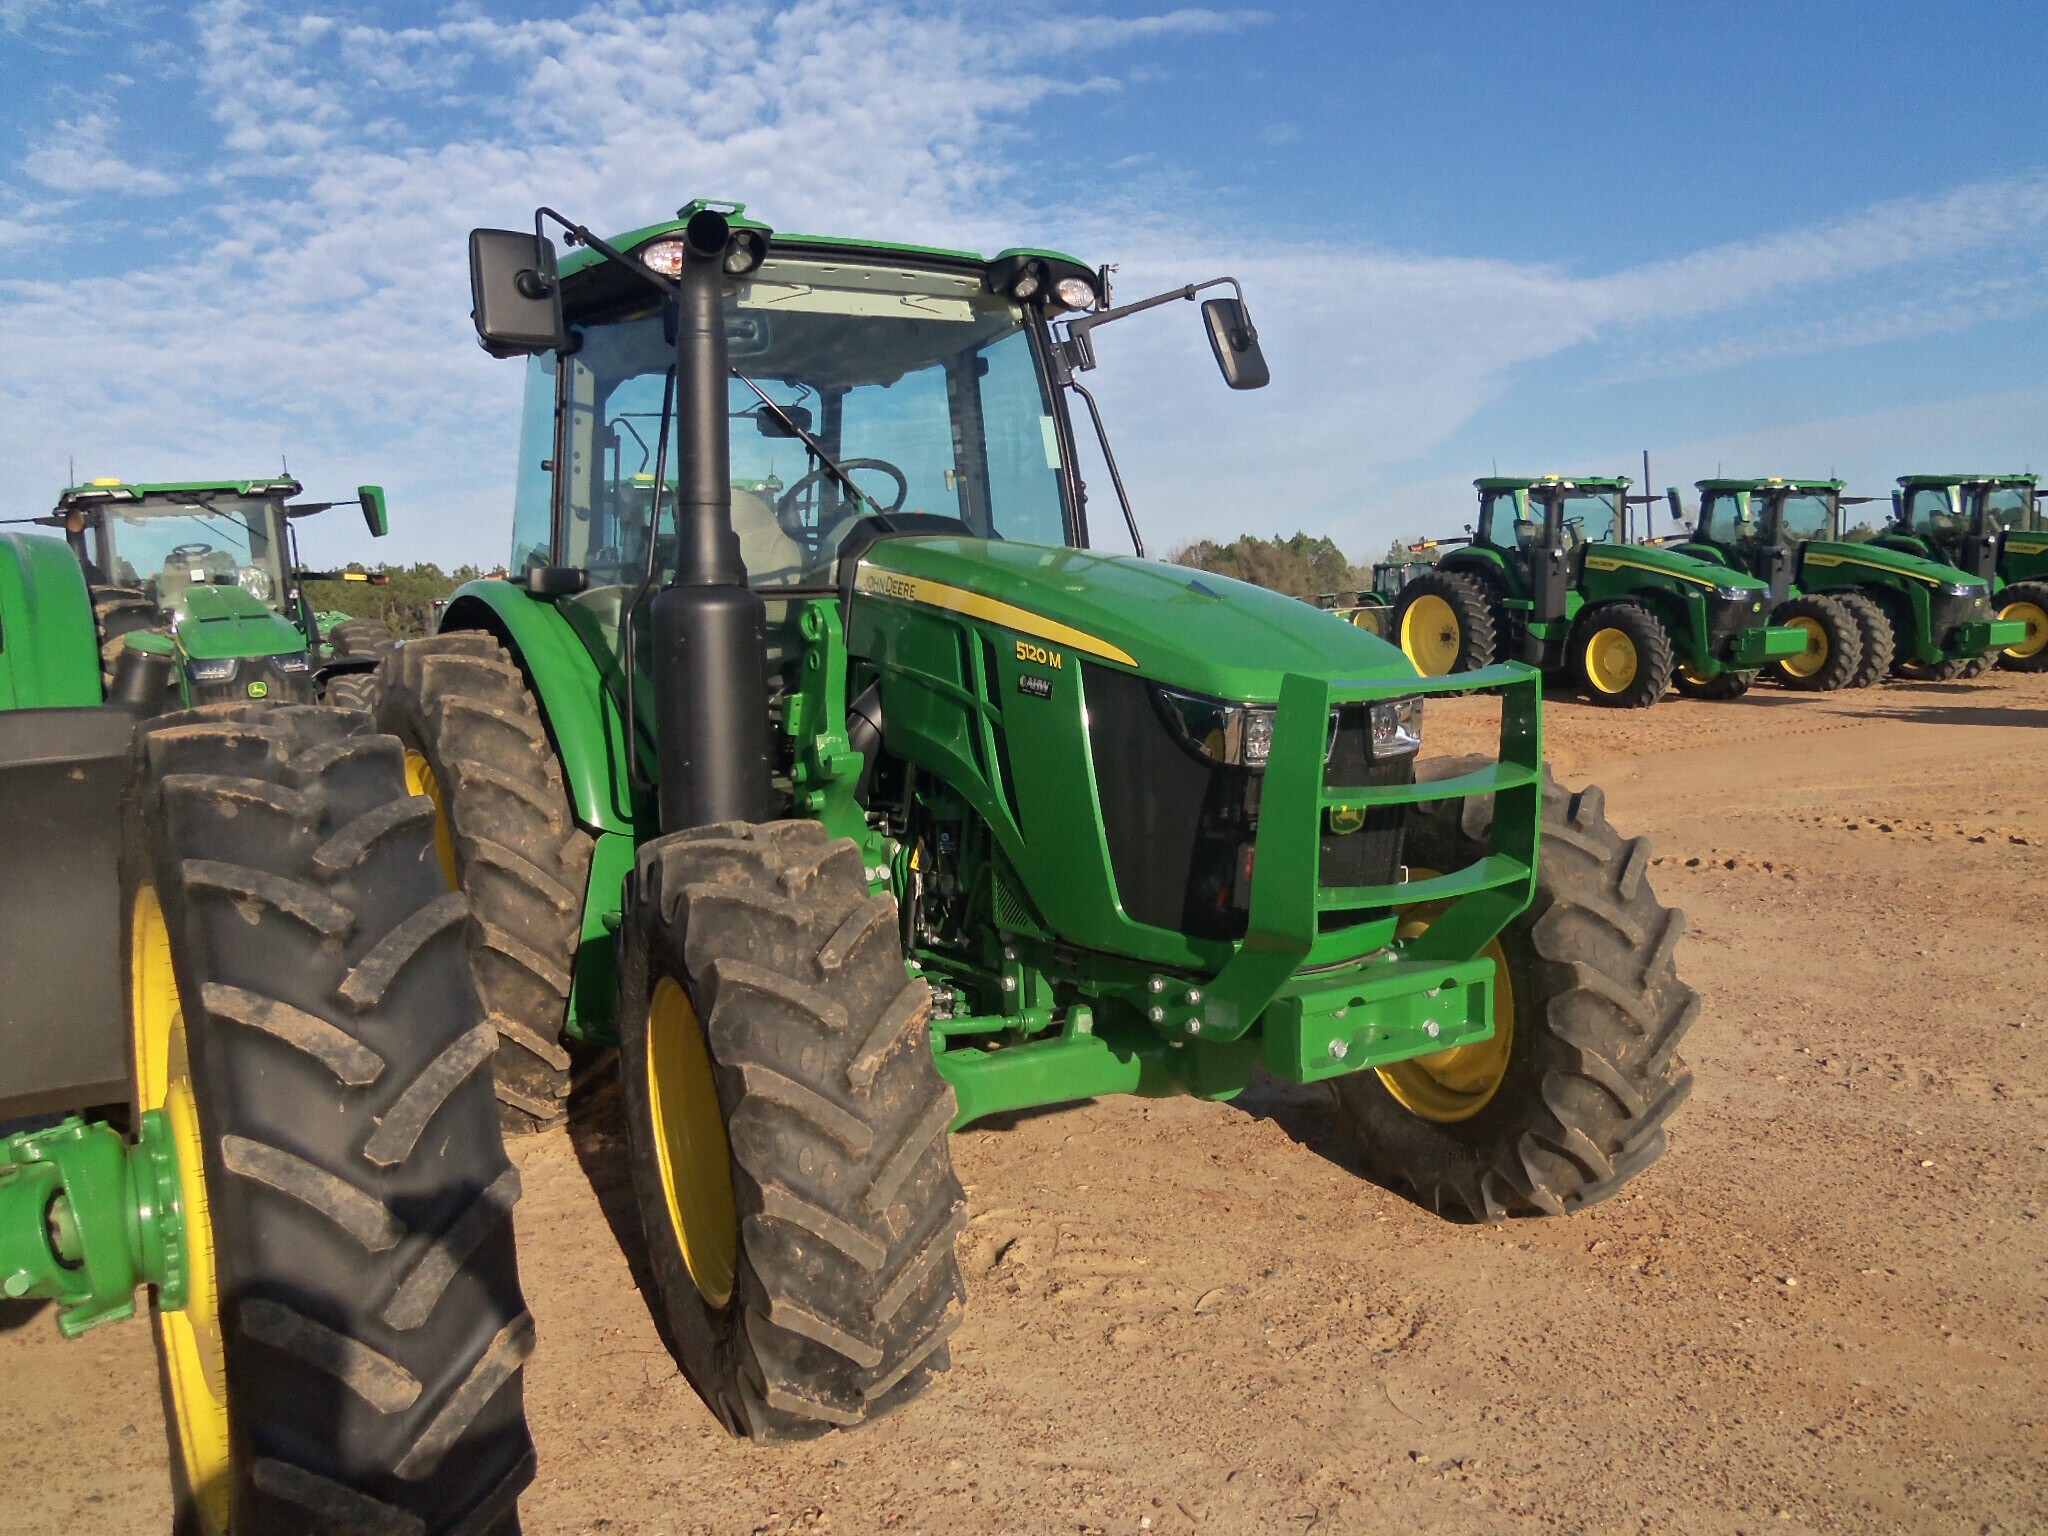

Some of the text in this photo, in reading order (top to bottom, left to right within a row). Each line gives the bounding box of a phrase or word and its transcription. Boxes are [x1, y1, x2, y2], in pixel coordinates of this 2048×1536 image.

[864, 573, 917, 598] JOHN DEERE
[1016, 640, 1047, 664] 5120
